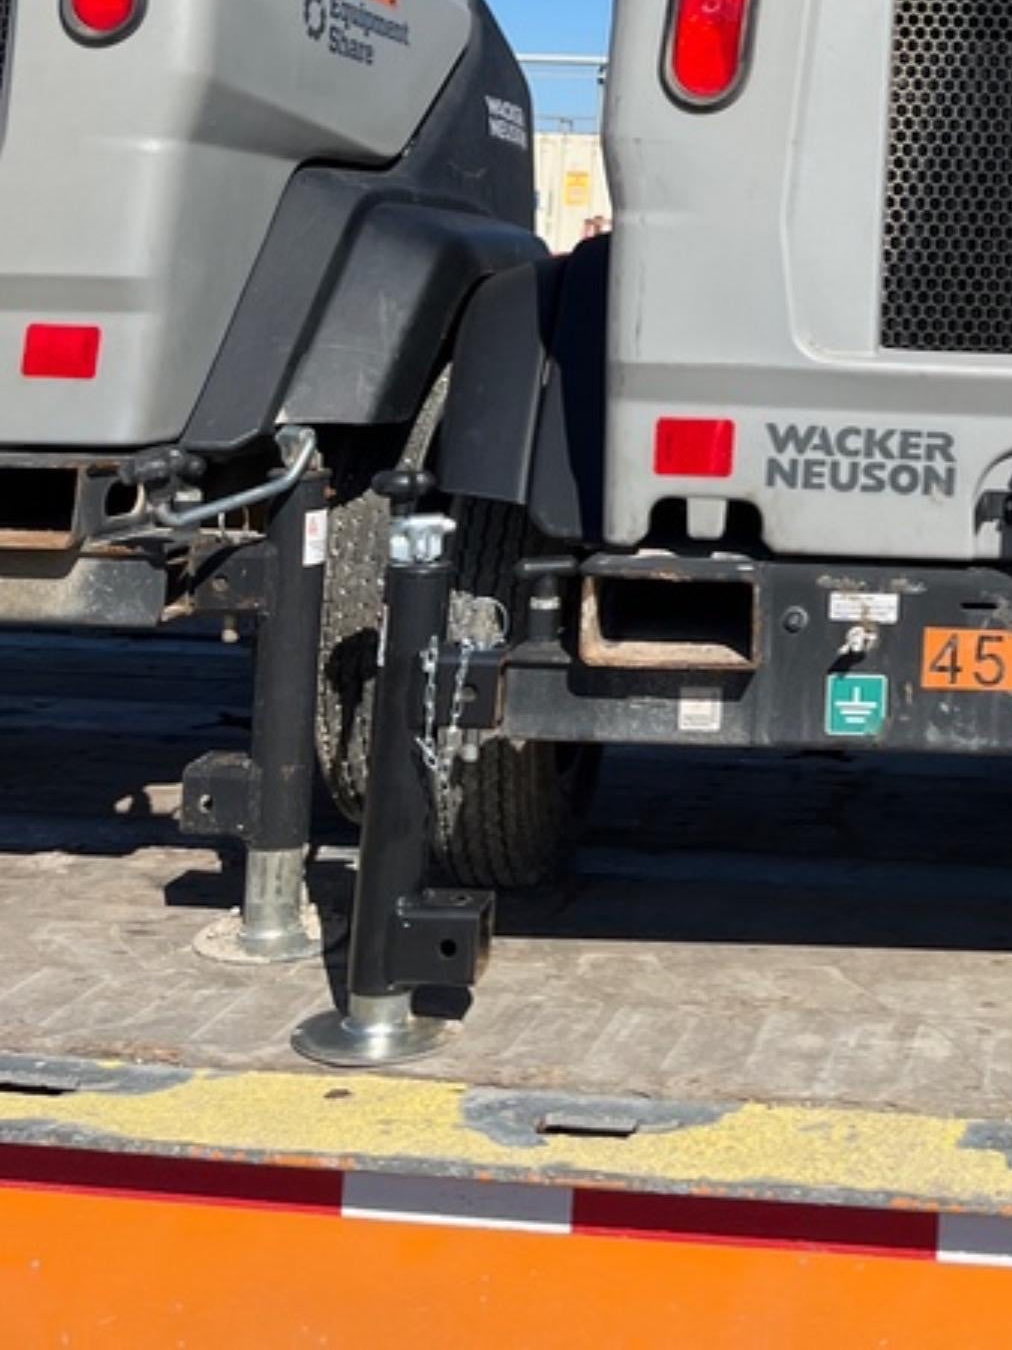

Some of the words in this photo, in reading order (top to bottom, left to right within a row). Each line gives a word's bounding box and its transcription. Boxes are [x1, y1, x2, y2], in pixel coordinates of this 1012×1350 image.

[328, 25, 374, 65] Share
[765, 422, 956, 463] WACKER
[765, 457, 956, 497] NEUSON
